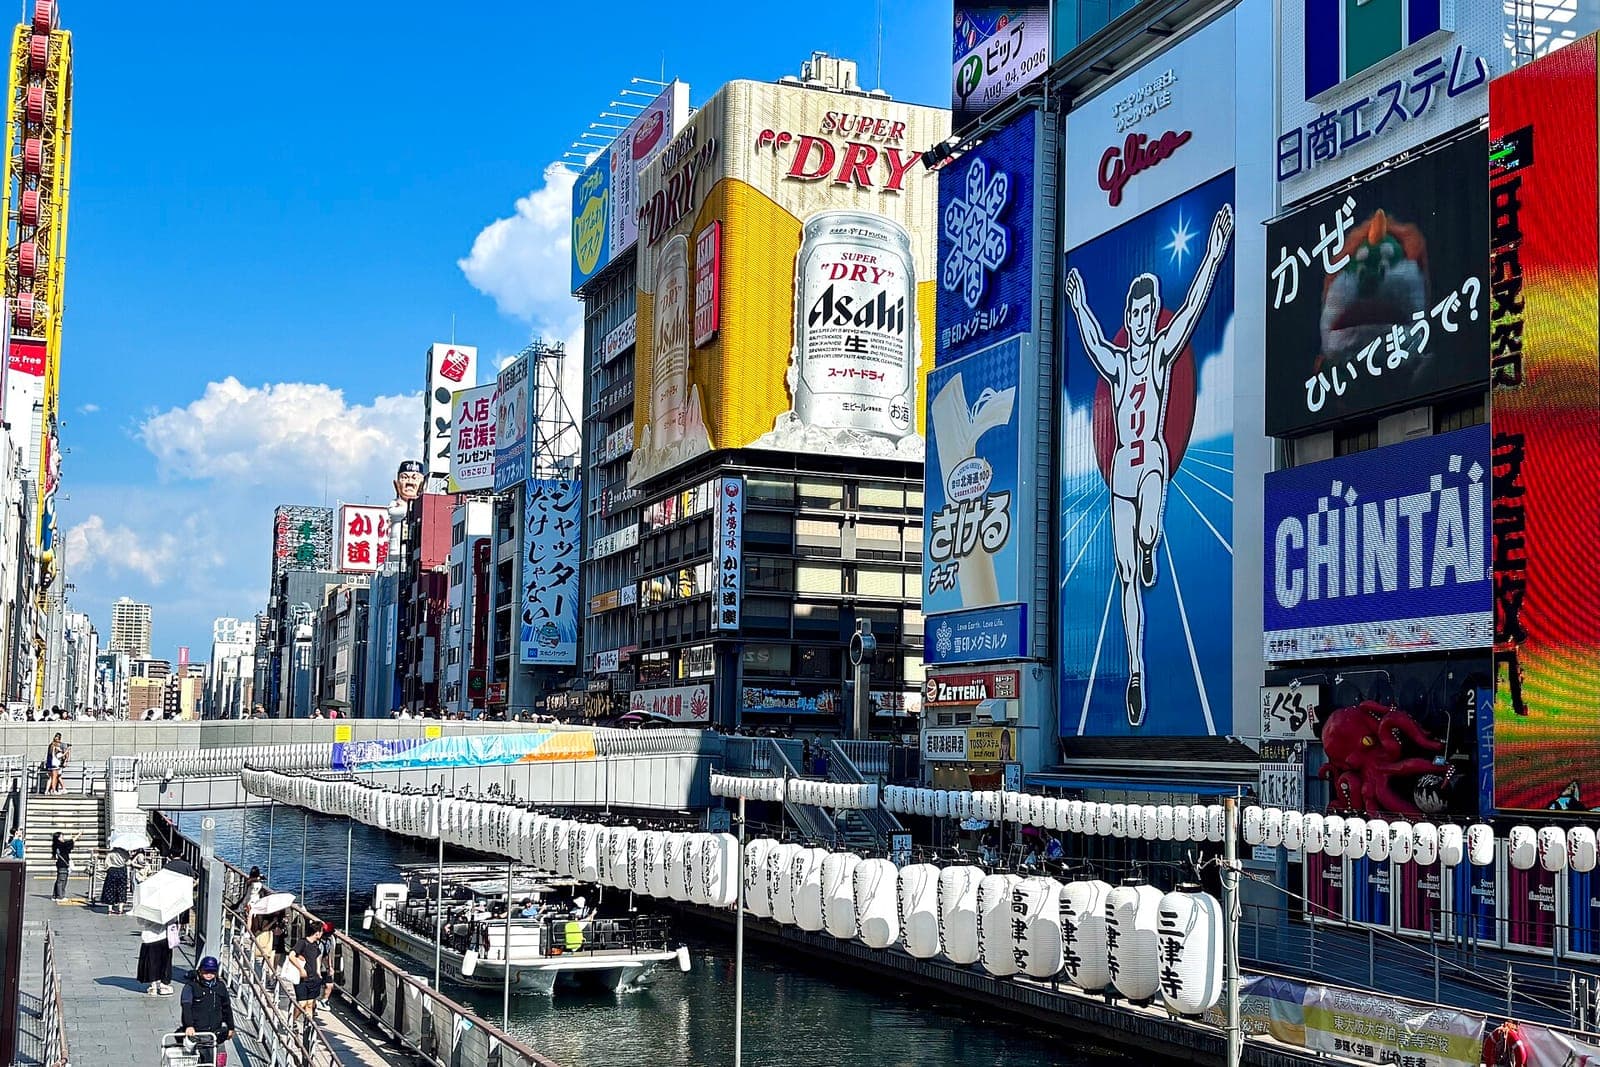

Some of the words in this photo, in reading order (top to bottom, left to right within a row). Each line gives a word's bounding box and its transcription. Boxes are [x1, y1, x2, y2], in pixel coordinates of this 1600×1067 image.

[983, 80, 1004, 102] Aug.
[1005, 68, 1019, 87] 24,
[1020, 48, 1046, 76] 2026
[986, 22, 1024, 76] ピップ
[824, 111, 906, 140] SUPER
[1277, 45, 1487, 183] 日商エステム
[661, 125, 695, 177] SUPER
[1098, 130, 1192, 207] Glico
[840, 252, 877, 265] SUPER
[1272, 195, 1356, 309] かぜ
[808, 283, 904, 336] Asahi
[942, 302, 1008, 349] 雪印メグミルク
[844, 334, 868, 354] 生
[828, 368, 885, 382] スーパードライ
[458, 398, 490, 425] 入店
[1129, 376, 1148, 468] グリコ
[549, 482, 577, 617] シャッター
[930, 490, 1012, 562] さける
[1275, 454, 1485, 609] CHINTAI
[522, 485, 553, 626] だけじゃない
[929, 562, 960, 595] チーズ
[954, 632, 1008, 653] 雪印メグミルク
[938, 682, 987, 700] ZETTERIA
[1271, 692, 1308, 732] くくる
[1466, 688, 1476, 727] 2F
[1012, 889, 1030, 974] 高津宮
[1058, 900, 1082, 978] 三津寺
[1104, 904, 1121, 982] 三津寺
[1158, 911, 1186, 1000] 三津寺
